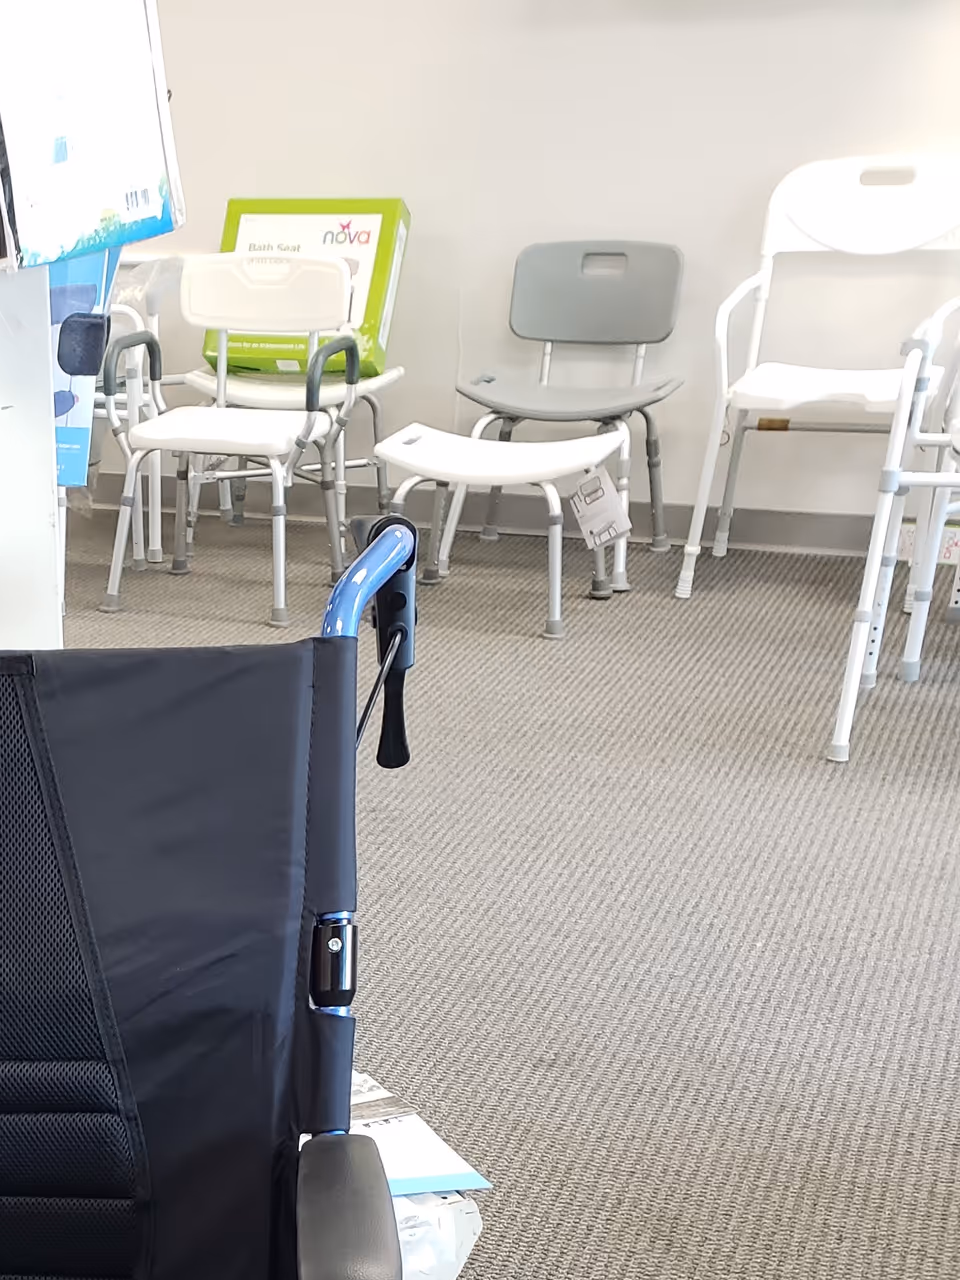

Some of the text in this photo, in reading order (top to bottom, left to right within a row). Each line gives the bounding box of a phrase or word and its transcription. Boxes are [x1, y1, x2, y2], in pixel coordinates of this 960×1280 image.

[322, 230, 372, 245] nova
[248, 243, 301, 252] Bath Seat
